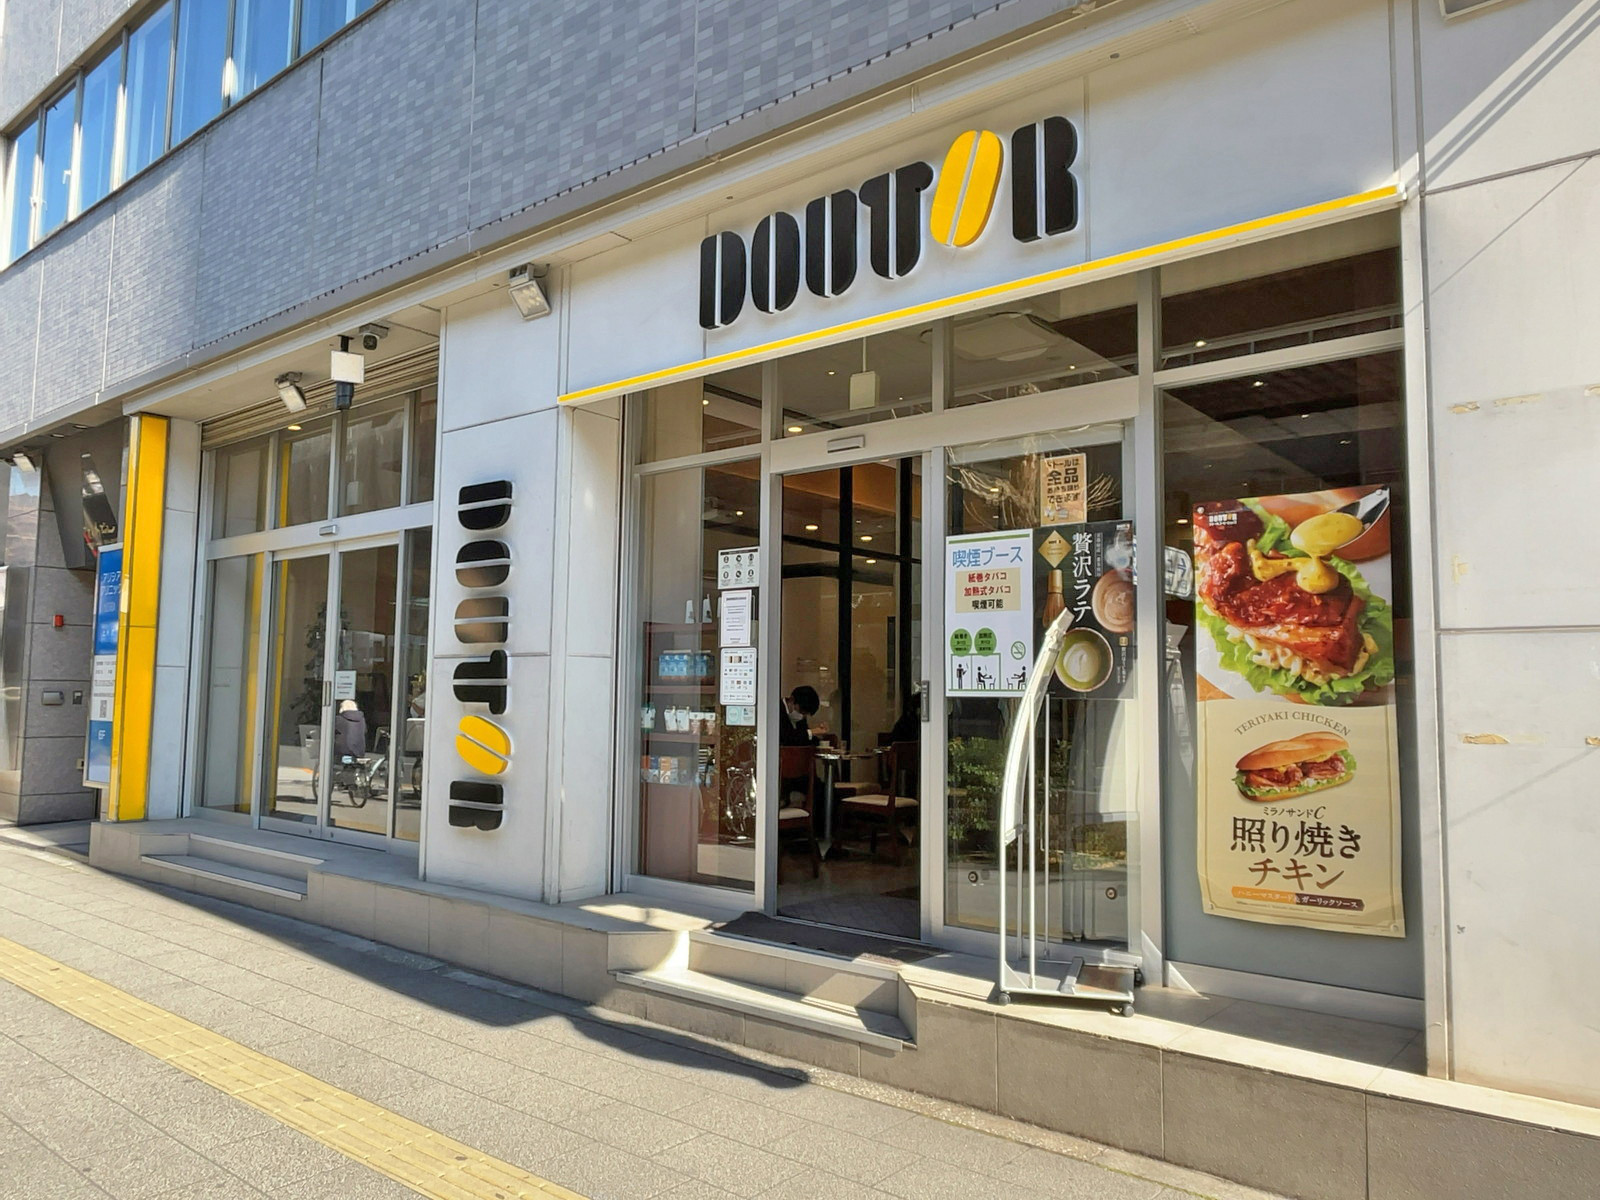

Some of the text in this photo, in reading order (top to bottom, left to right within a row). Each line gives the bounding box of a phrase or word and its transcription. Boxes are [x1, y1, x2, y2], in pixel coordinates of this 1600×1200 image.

[699, 115, 1079, 330] DOUTOR
[1047, 467, 1079, 486] 全品
[952, 546, 1023, 568] 喫煙ブース
[968, 572, 1007, 583] 紙巻タバコ
[1072, 532, 1093, 622] 贅沢ラテ
[964, 586, 1012, 597] 加熱式タバコ
[972, 599, 1004, 610] 喫煙可能
[449, 480, 513, 832] DOUTOR
[1235, 711, 1351, 736] TERIYAKI CHICKEN
[1263, 806, 1326, 820] ミラノサンドC
[1230, 816, 1361, 859] 照り焼き
[1248, 858, 1345, 891] チキン
